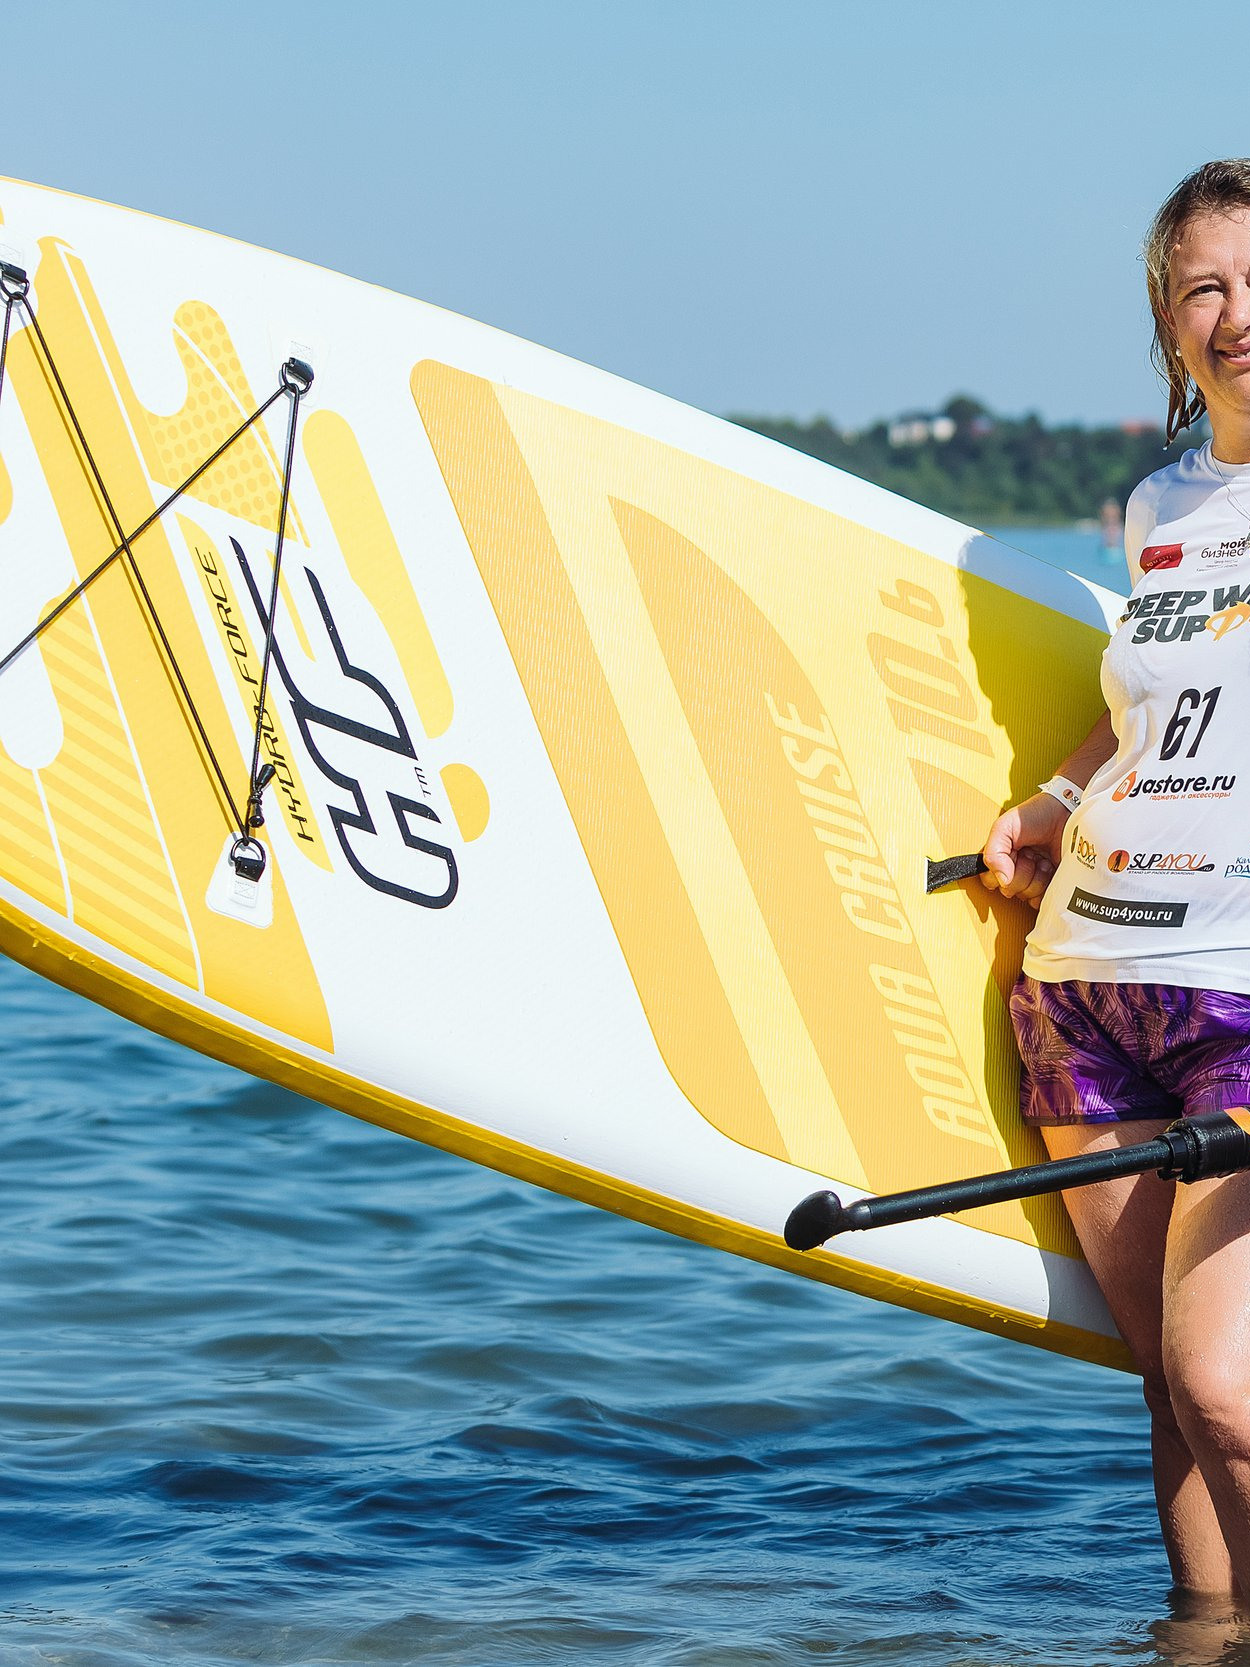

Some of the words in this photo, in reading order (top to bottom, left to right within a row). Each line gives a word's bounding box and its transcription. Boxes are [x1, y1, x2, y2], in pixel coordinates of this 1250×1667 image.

[1201, 548, 1244, 558] бизнес
[1220, 537, 1246, 549] мой
[1120, 590, 1207, 623] DEEP
[1159, 686, 1222, 760] 61
[764, 690, 915, 945] CRUISE
[1129, 853, 1207, 870] SUP4YOU
[1075, 898, 1172, 921] www.sup4you.ru
